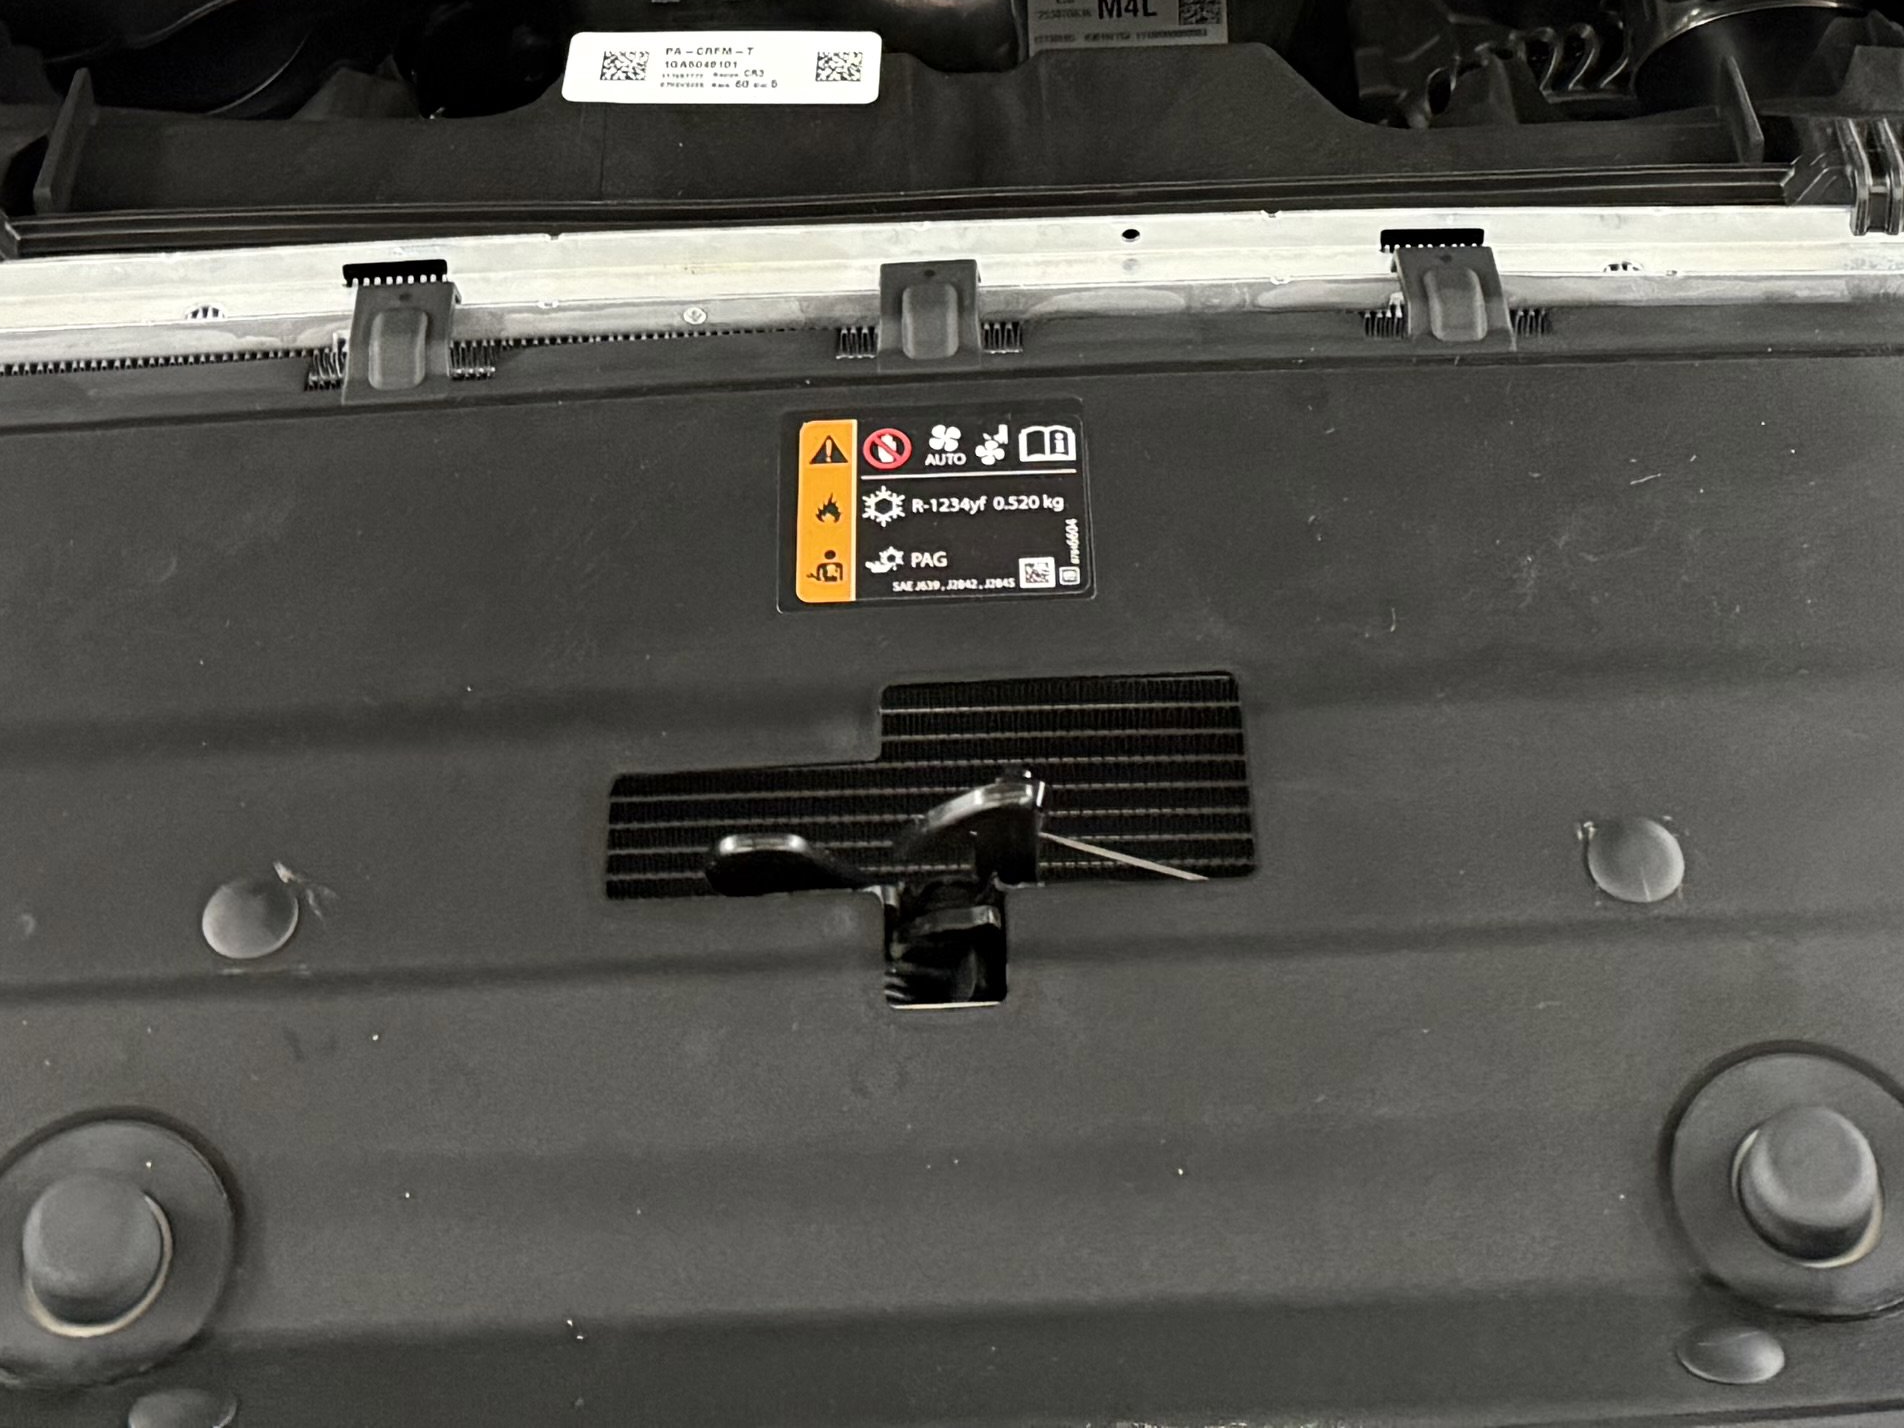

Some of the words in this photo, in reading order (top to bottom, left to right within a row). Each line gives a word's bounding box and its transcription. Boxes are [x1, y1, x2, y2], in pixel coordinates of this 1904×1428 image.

[924, 452, 967, 467] AUTO
[912, 495, 987, 516] R-1234yf
[993, 495, 1040, 511] 0.520
[1043, 494, 1064, 512] kg
[911, 551, 948, 568] PAG
[892, 580, 913, 592] SAE
